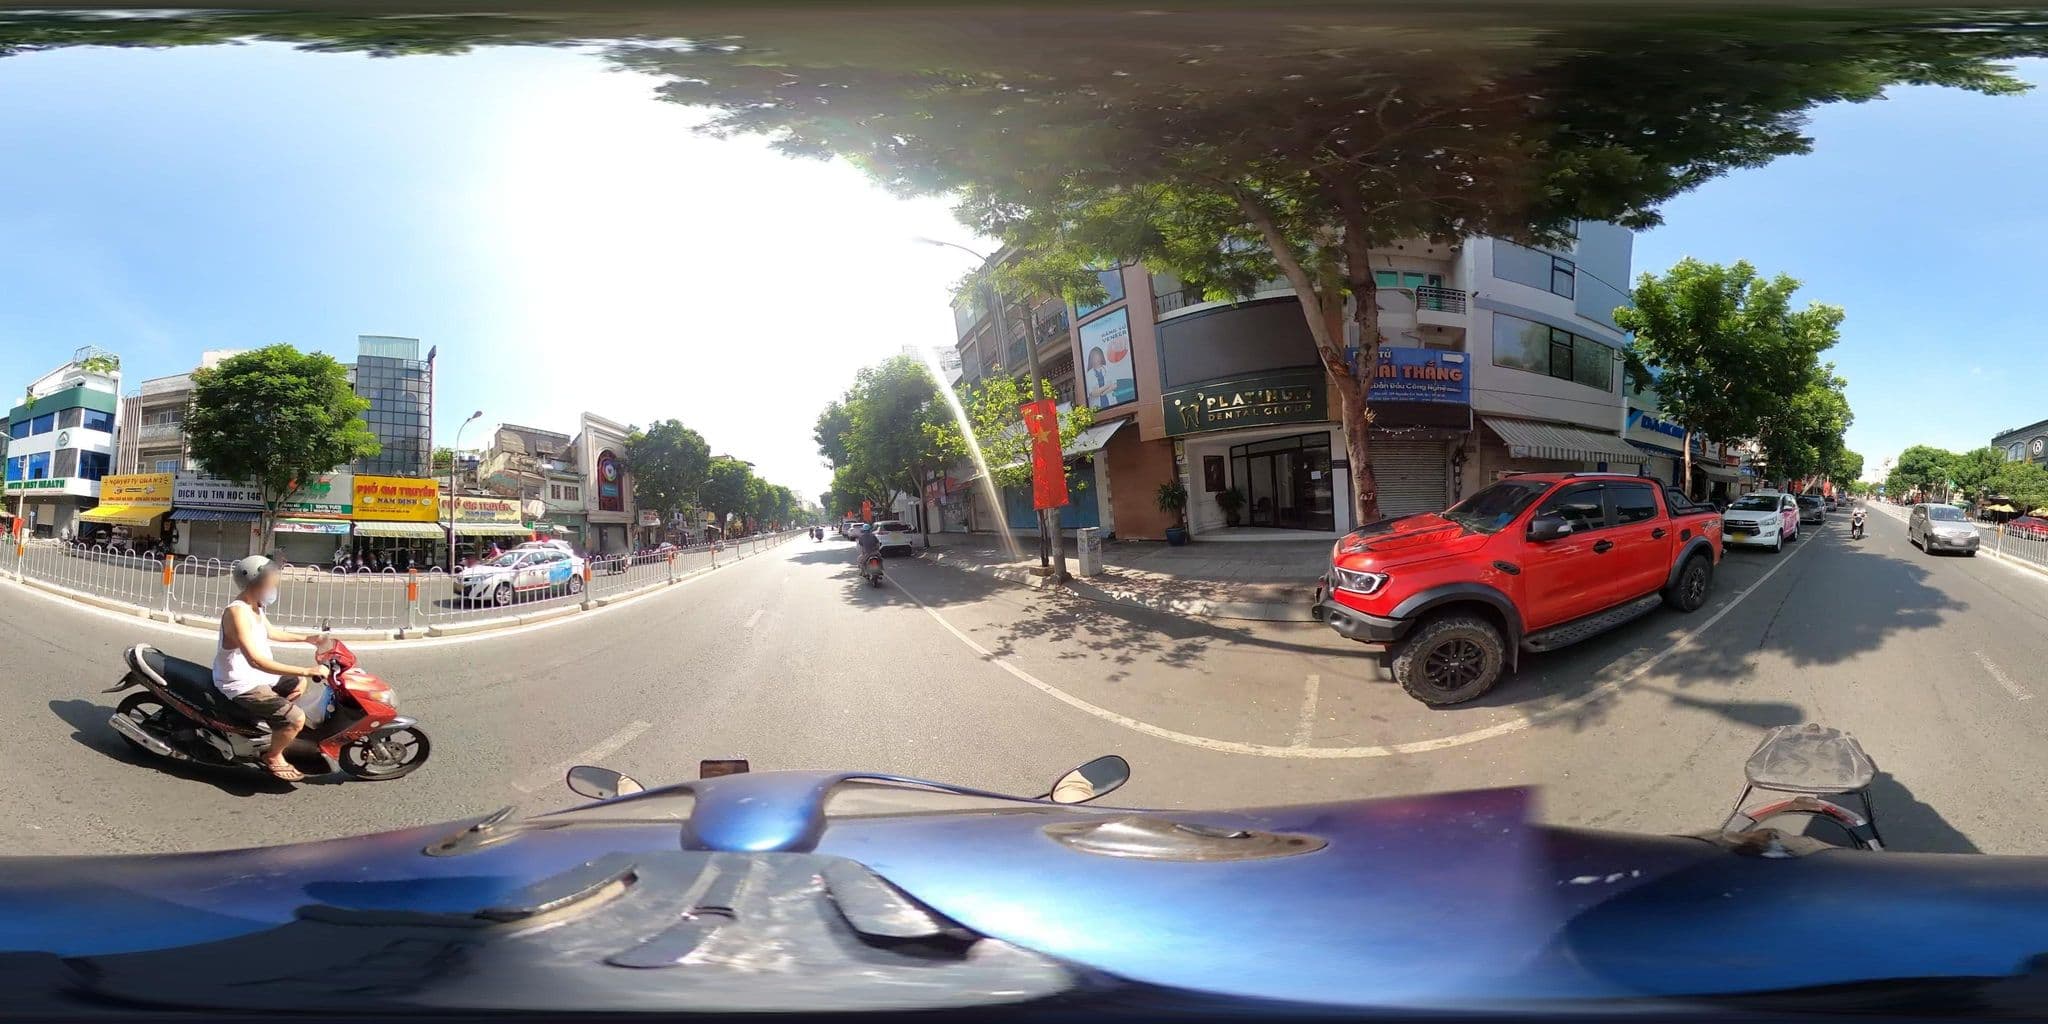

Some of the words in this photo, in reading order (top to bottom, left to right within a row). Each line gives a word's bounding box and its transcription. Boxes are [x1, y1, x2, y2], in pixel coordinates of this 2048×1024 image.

[1403, 361, 1463, 381] THẮNG
[1208, 409, 1259, 421] DENTAL
[1264, 404, 1312, 415] GROUP
[39, 480, 65, 488] HEALTH
[357, 482, 378, 494] PHỞ
[178, 489, 195, 500] DỊCH
[197, 490, 208, 500] VỤ
[212, 490, 224, 499] TIN
[227, 491, 244, 501] HỌC
